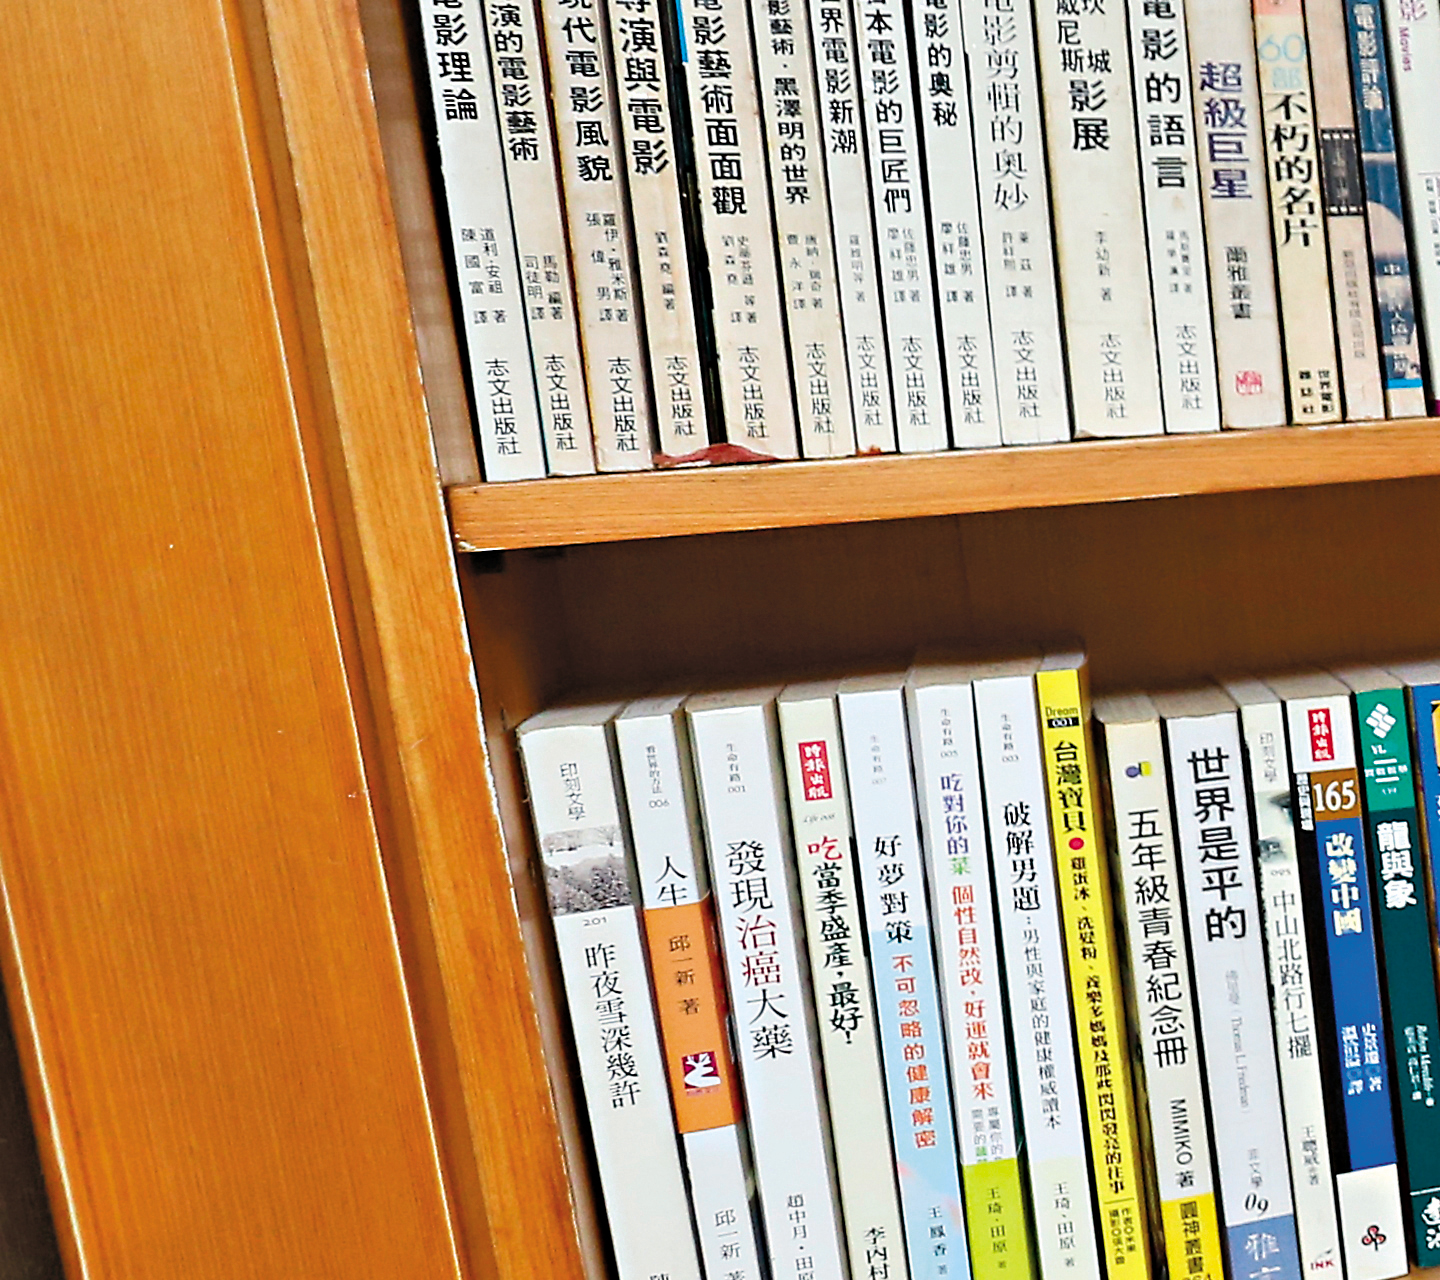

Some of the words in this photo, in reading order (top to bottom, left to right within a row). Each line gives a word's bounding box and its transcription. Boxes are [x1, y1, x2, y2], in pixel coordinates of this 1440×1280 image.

[1199, 61, 1253, 200] 超級巨星
[1268, 91, 1320, 248] 不朽的名片
[485, 358, 522, 456] 志文出版社
[543, 353, 578, 452] 志文出版社
[608, 356, 640, 452] 志文出版社
[665, 355, 698, 437] 志文出版社
[737, 345, 770, 439] 志文出版社
[805, 342, 835, 435] 志文出版社
[856, 334, 884, 427] 志文出版社
[901, 334, 932, 427] 志文出版社
[956, 333, 985, 425] 志文出版社
[1010, 329, 1042, 420] 志文出版社
[1099, 332, 1129, 420] 志文出版社
[1175, 324, 1204, 411] 志文出版社
[1044, 705, 1079, 718] Dream
[940, 772, 974, 876] 吃對你的菜
[1052, 740, 1089, 834] 台灣寶貝
[1313, 781, 1357, 812] 165
[654, 855, 689, 907] 人生
[872, 835, 915, 945] 好夢對策
[1186, 746, 1247, 943] 世界是平的
[1324, 832, 1365, 937] 改變中國
[1376, 821, 1418, 910] 龍與象
[668, 933, 697, 986] 邱一新
[724, 840, 794, 1061] 發現治癌大藥
[1126, 807, 1190, 1069] 五年級青春紀念冊
[1273, 890, 1313, 1059] 中山北路行七擺
[583, 942, 643, 1109] 昨夜雪深幾許
[892, 954, 938, 1149] 不可忽略的健康解密
[1169, 1098, 1194, 1167] MIMIKO
[713, 1208, 742, 1260] 邱一新
